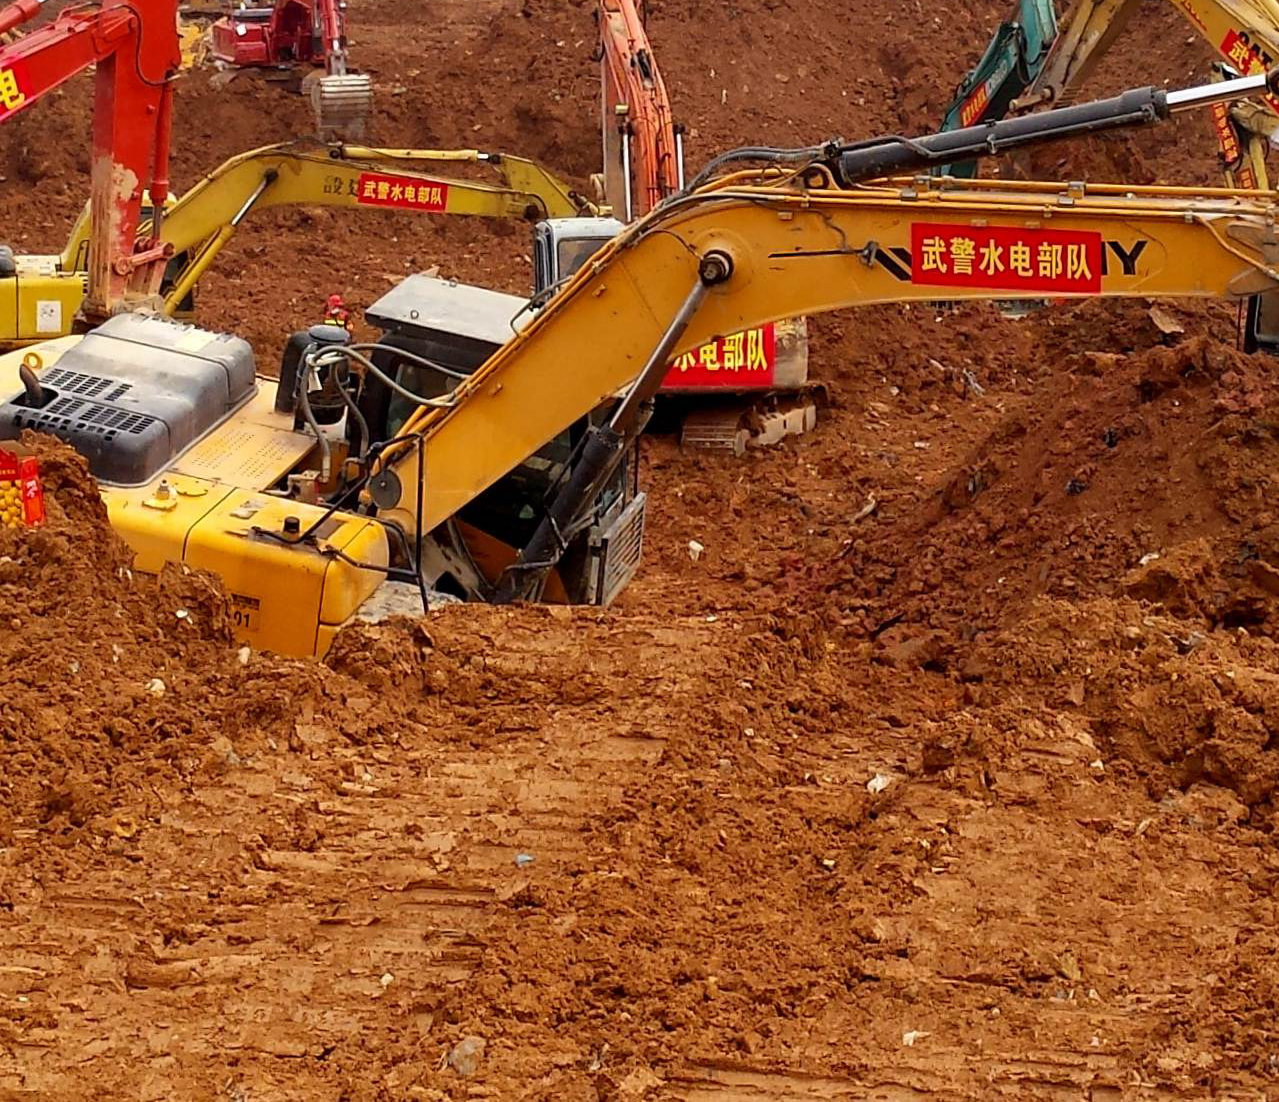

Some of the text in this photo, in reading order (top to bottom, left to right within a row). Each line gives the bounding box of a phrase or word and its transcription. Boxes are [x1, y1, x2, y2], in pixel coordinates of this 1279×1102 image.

[362, 180, 443, 206] 武警水电部队
[921, 235, 1093, 281] 武警水电部队
